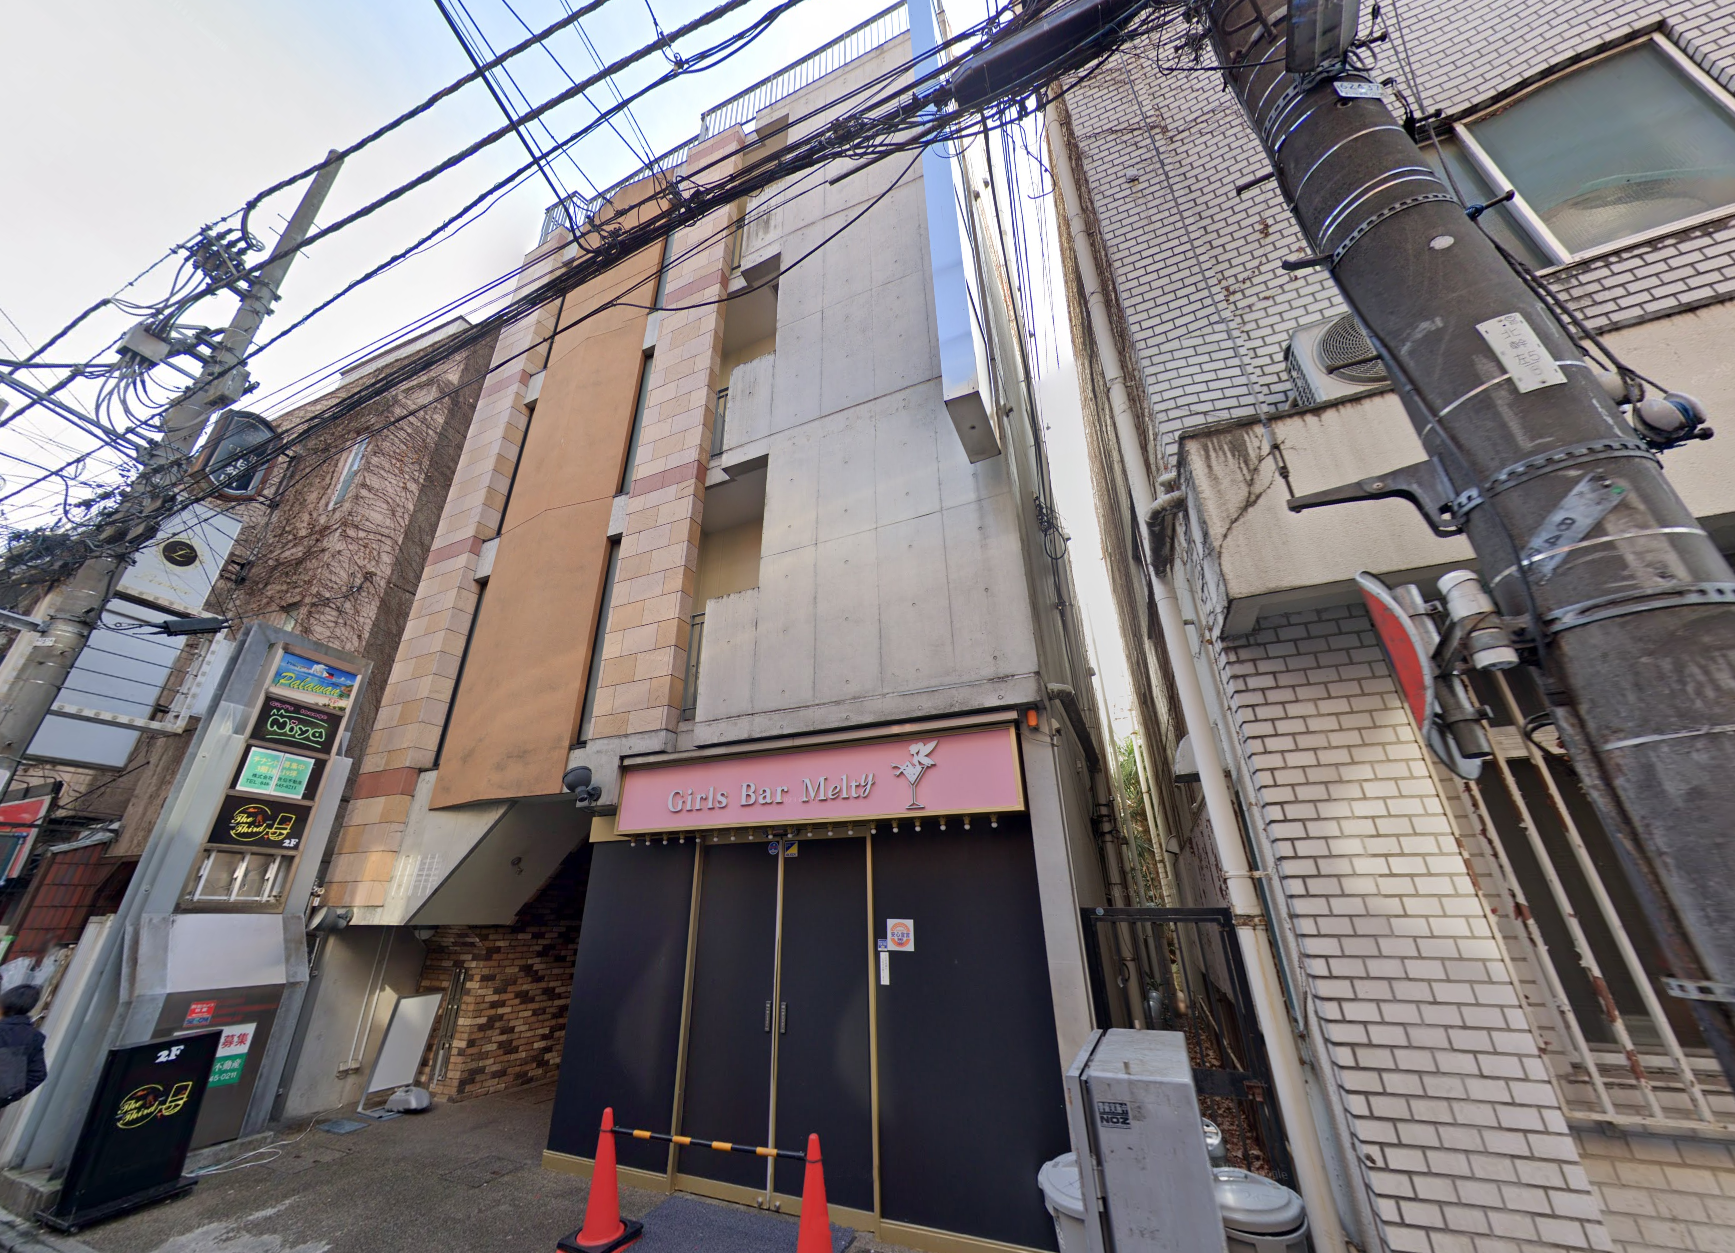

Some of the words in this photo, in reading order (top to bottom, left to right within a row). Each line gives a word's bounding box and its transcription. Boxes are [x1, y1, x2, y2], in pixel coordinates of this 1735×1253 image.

[276, 672, 341, 697] Palawan
[667, 785, 729, 813] Girls
[740, 782, 789, 806] Bar
[802, 772, 875, 803] Melty
[231, 813, 256, 824] The
[232, 823, 267, 834] Third
[282, 839, 299, 847] 2F
[221, 1032, 250, 1049] 募集
[154, 1045, 185, 1064] 2F
[214, 1058, 242, 1072] 不動産
[117, 1099, 144, 1115] The
[119, 1101, 160, 1124] Third
[1099, 1115, 1131, 1125] NOZ
